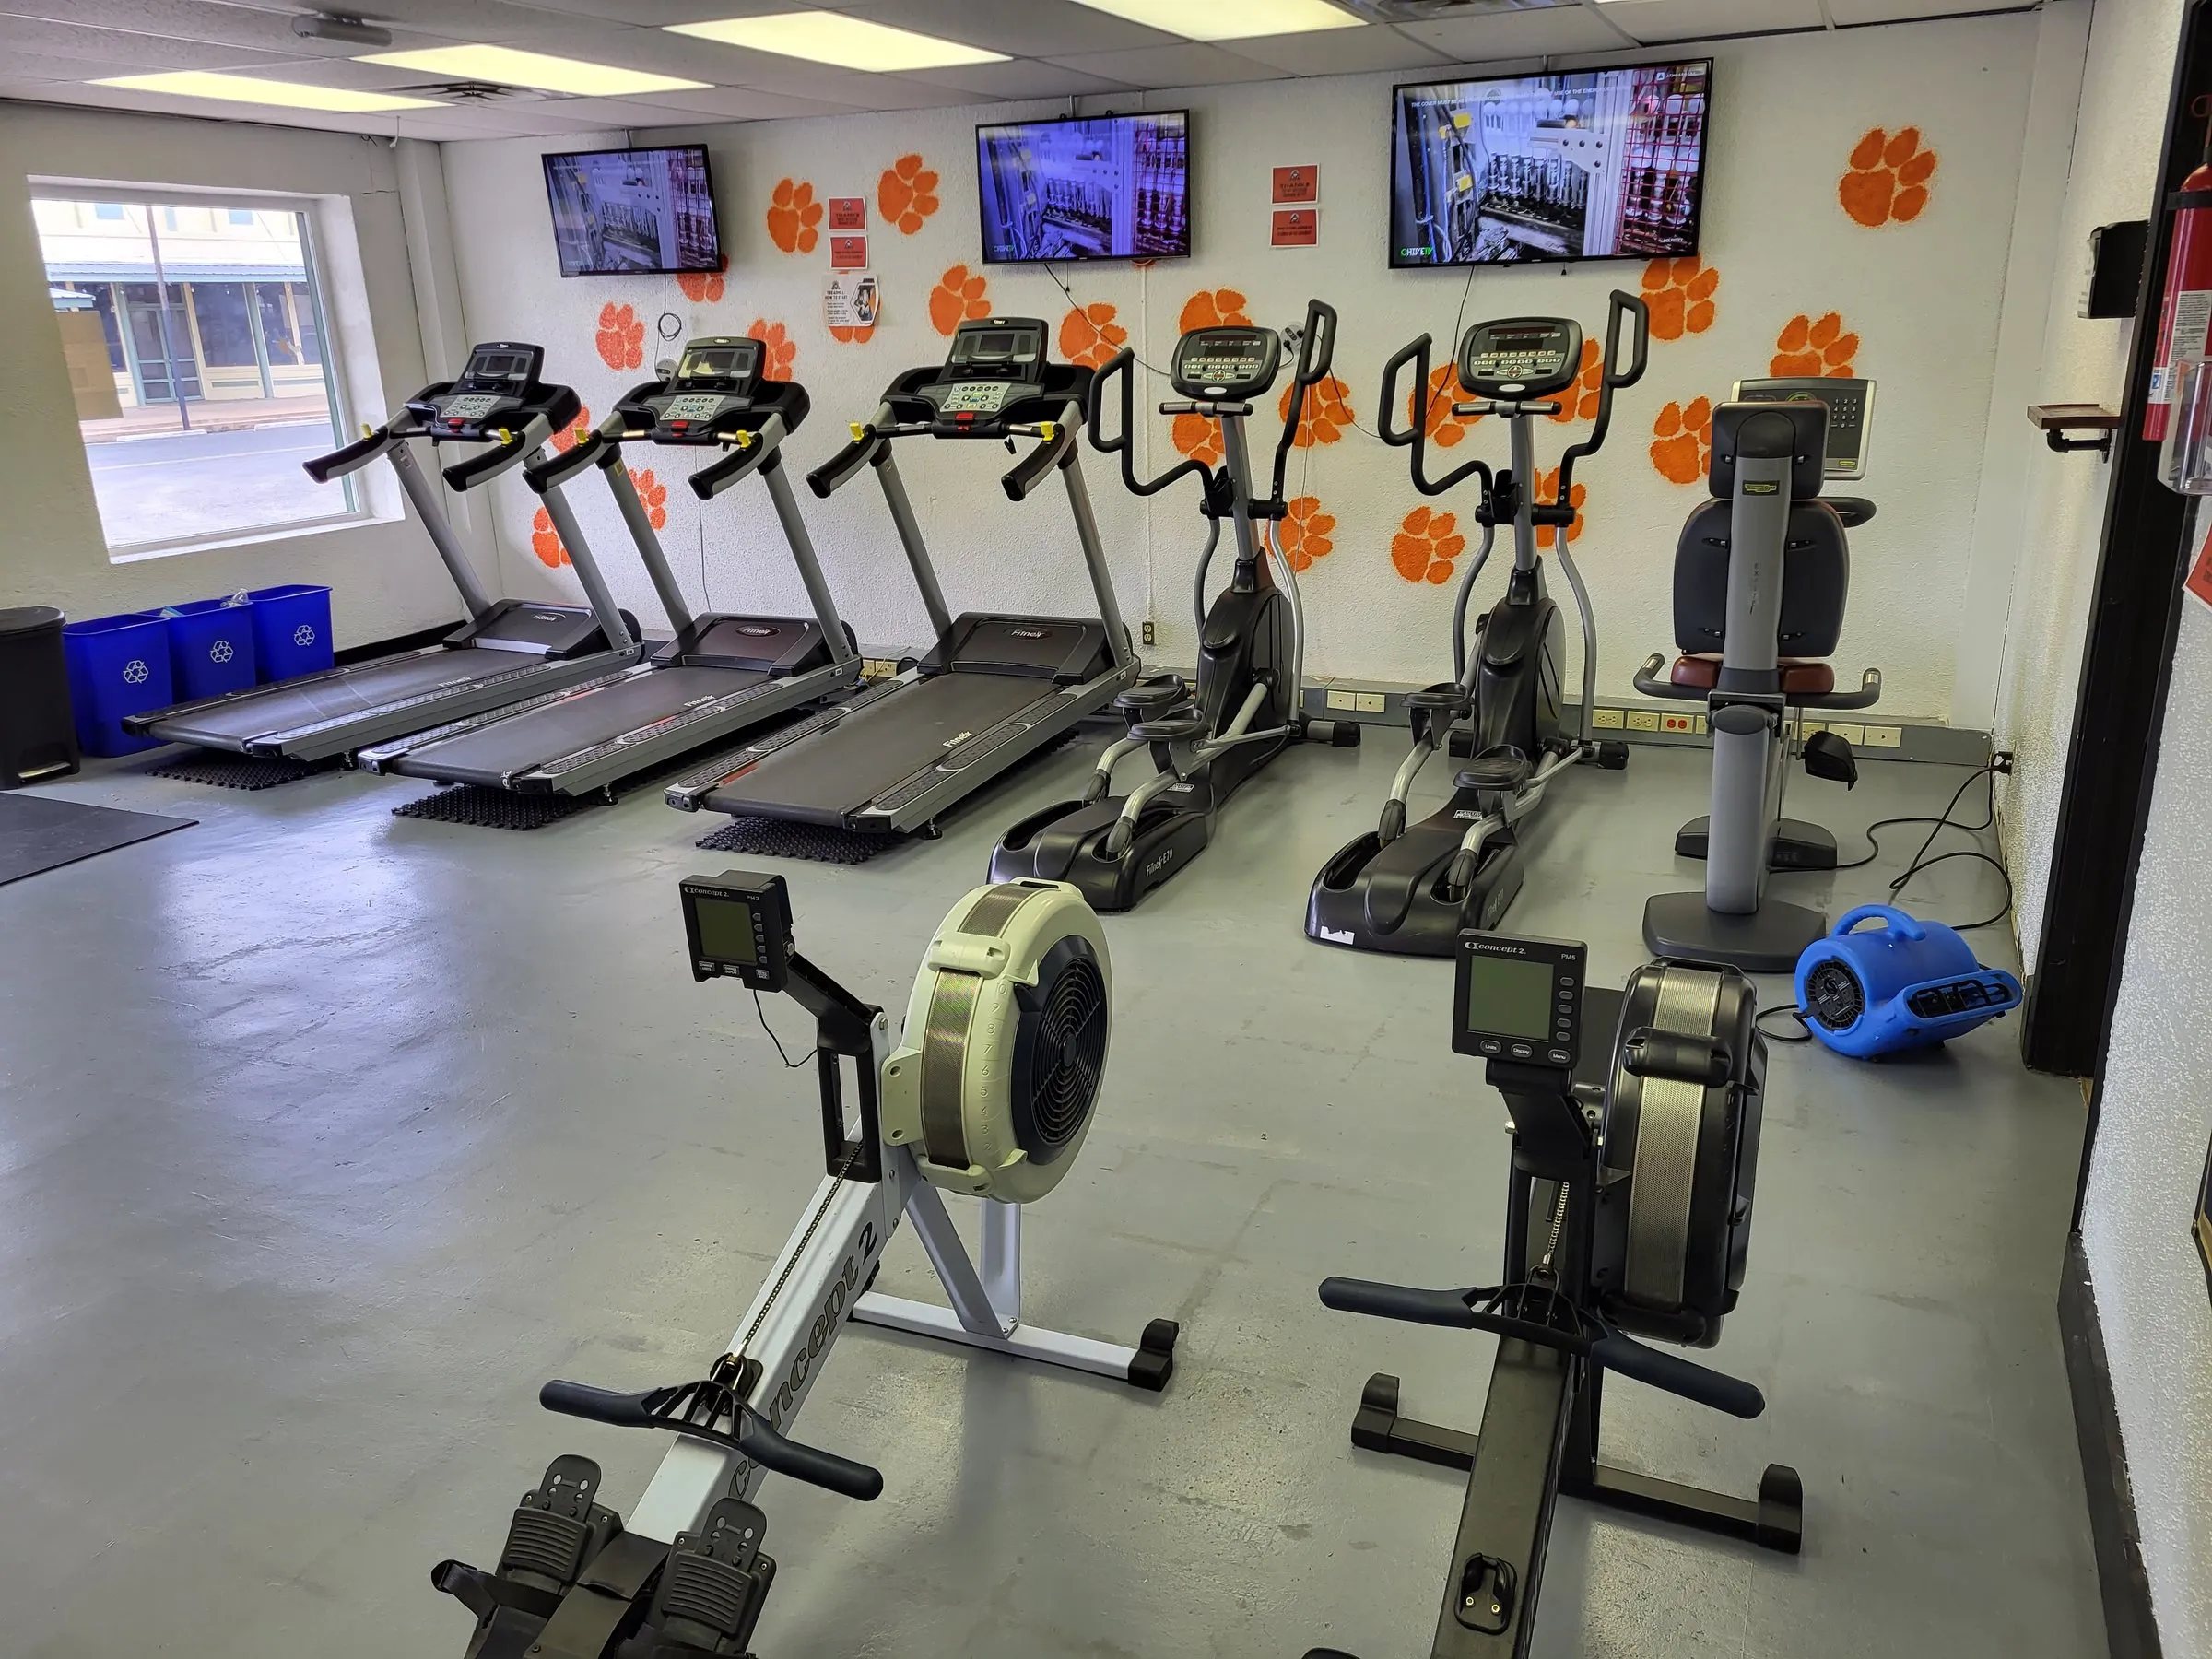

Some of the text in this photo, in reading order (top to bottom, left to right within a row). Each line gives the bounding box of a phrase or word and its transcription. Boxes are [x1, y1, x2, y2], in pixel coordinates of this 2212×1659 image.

[694, 888, 723, 897] concept
[1478, 943, 1517, 954] concept
[987, 1023, 996, 1035] 8
[982, 1043, 994, 1056] 7
[981, 1065, 990, 1077] 6
[980, 1086, 989, 1099] 5
[859, 1221, 877, 1266] 2
